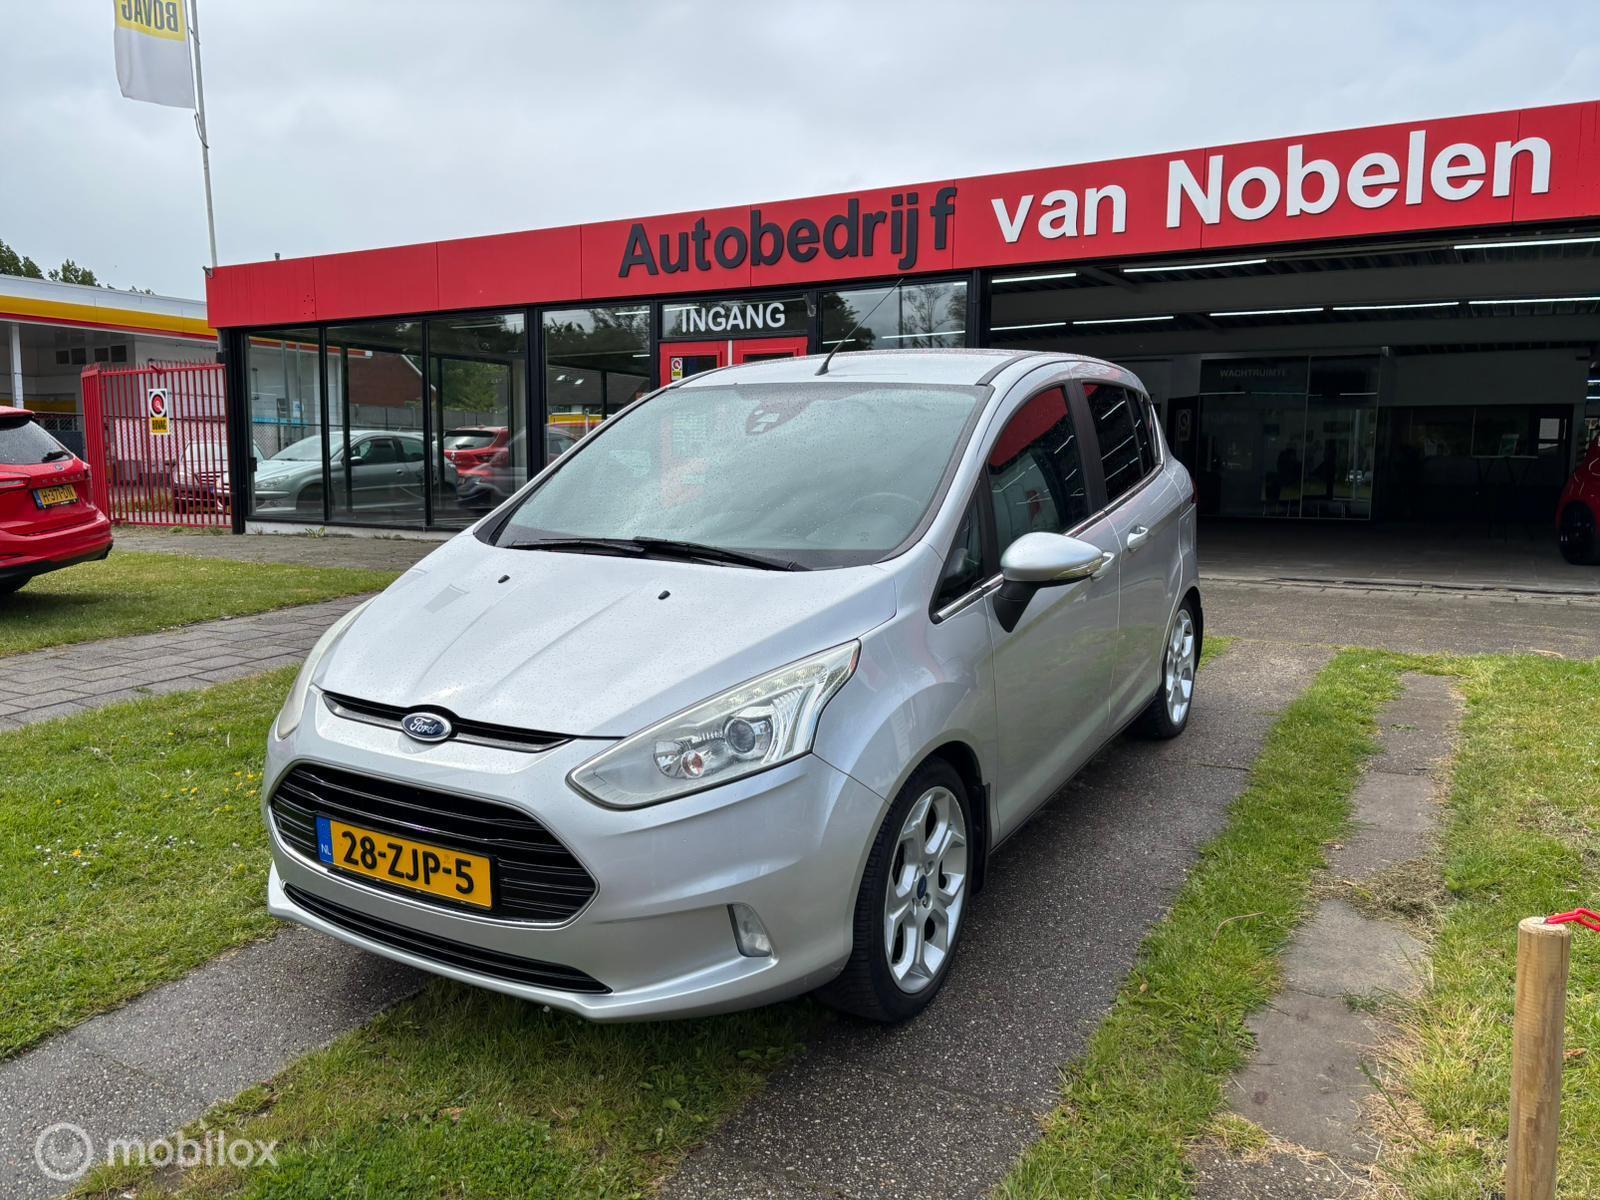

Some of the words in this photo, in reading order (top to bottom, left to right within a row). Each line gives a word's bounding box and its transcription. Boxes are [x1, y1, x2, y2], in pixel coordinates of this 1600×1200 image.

[618, 186, 957, 278] Autobedrijf
[991, 183, 1127, 243] van
[1166, 130, 1552, 229] Nobelen
[681, 302, 786, 333] INGANG
[409, 716, 440, 735] Ford
[320, 843, 331, 856] NL
[341, 830, 475, 895] 28-ZJP-5
